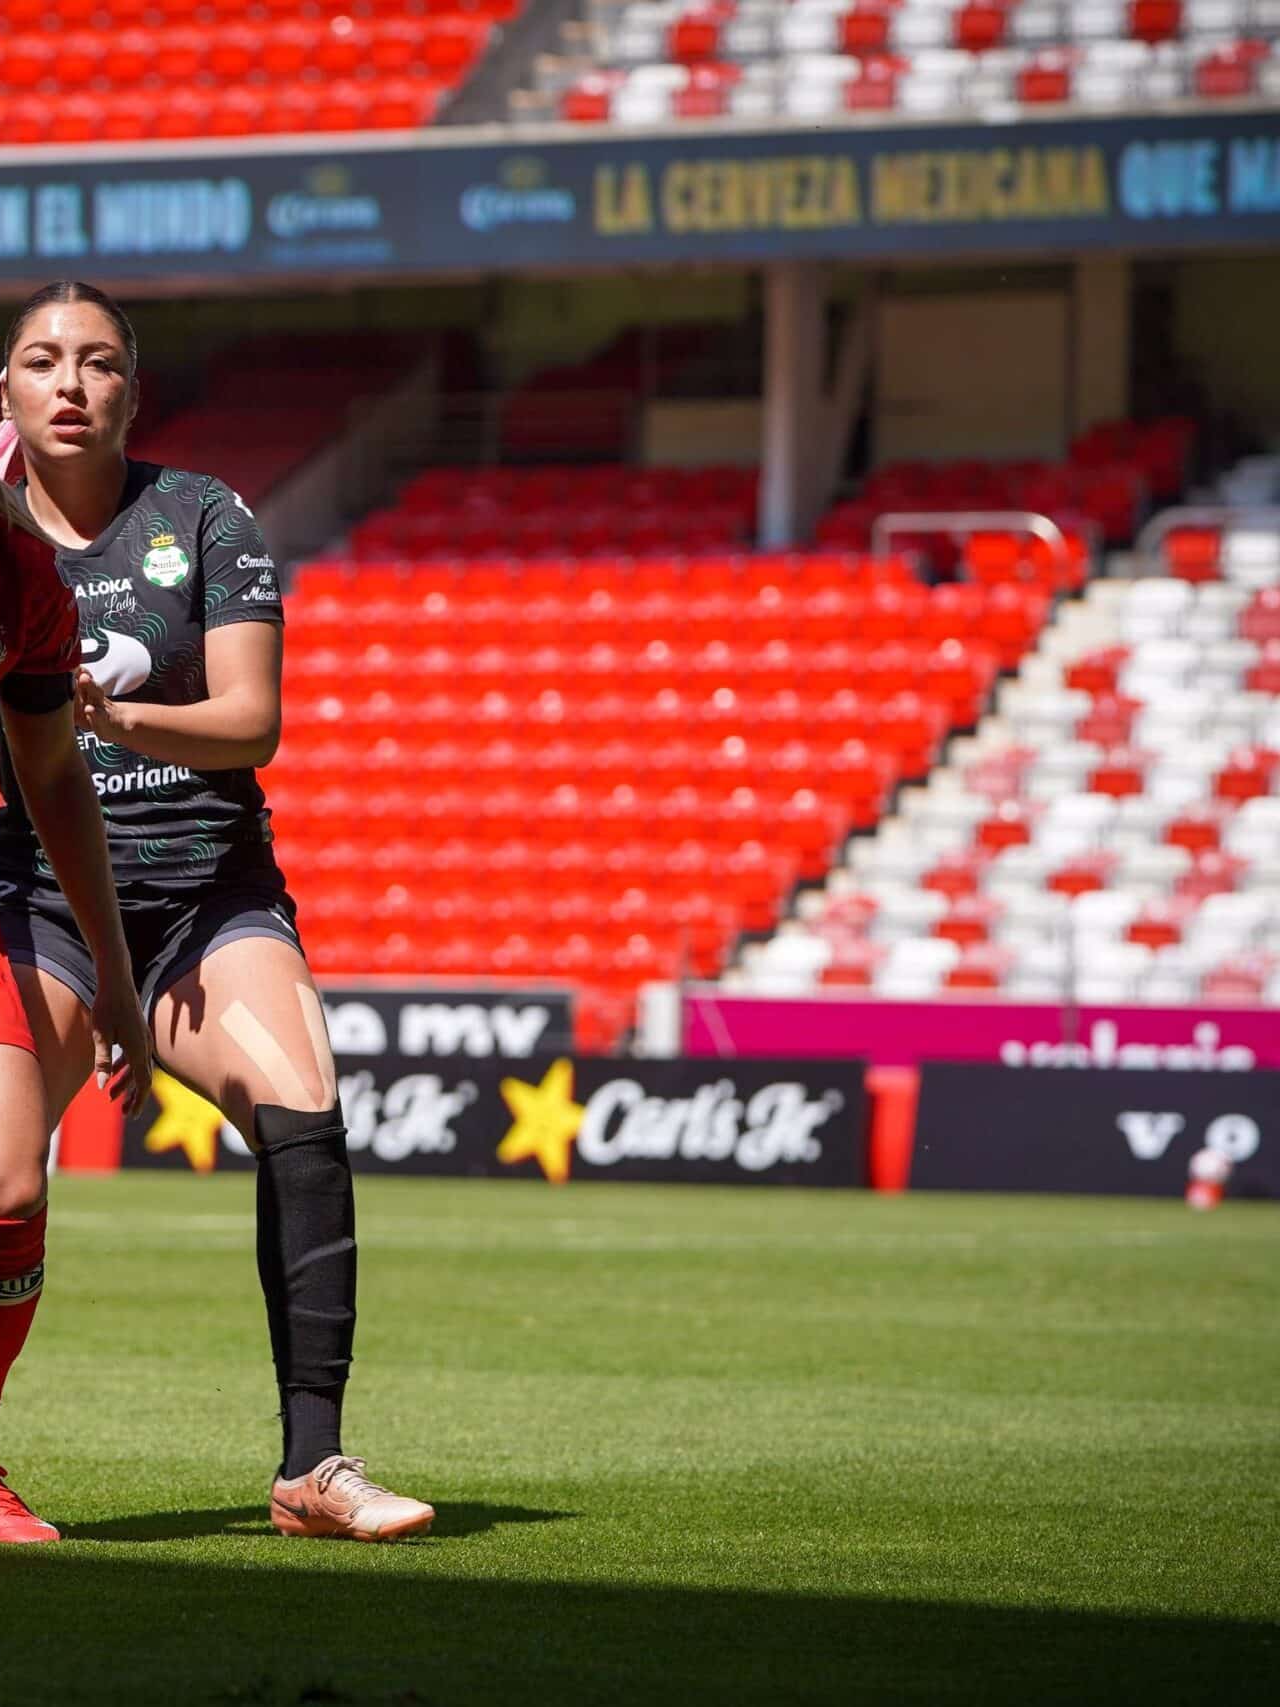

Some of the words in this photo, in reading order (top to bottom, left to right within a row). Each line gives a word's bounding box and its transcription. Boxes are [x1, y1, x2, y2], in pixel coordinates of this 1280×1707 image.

[36, 181, 89, 258] EL
[93, 175, 253, 255] MUNDO
[594, 162, 652, 236] LA
[663, 154, 859, 234] CERVEZA
[871, 144, 1110, 223] MEXICANA
[1121, 138, 1219, 219] QUE
[103, 590, 137, 618] Lady
